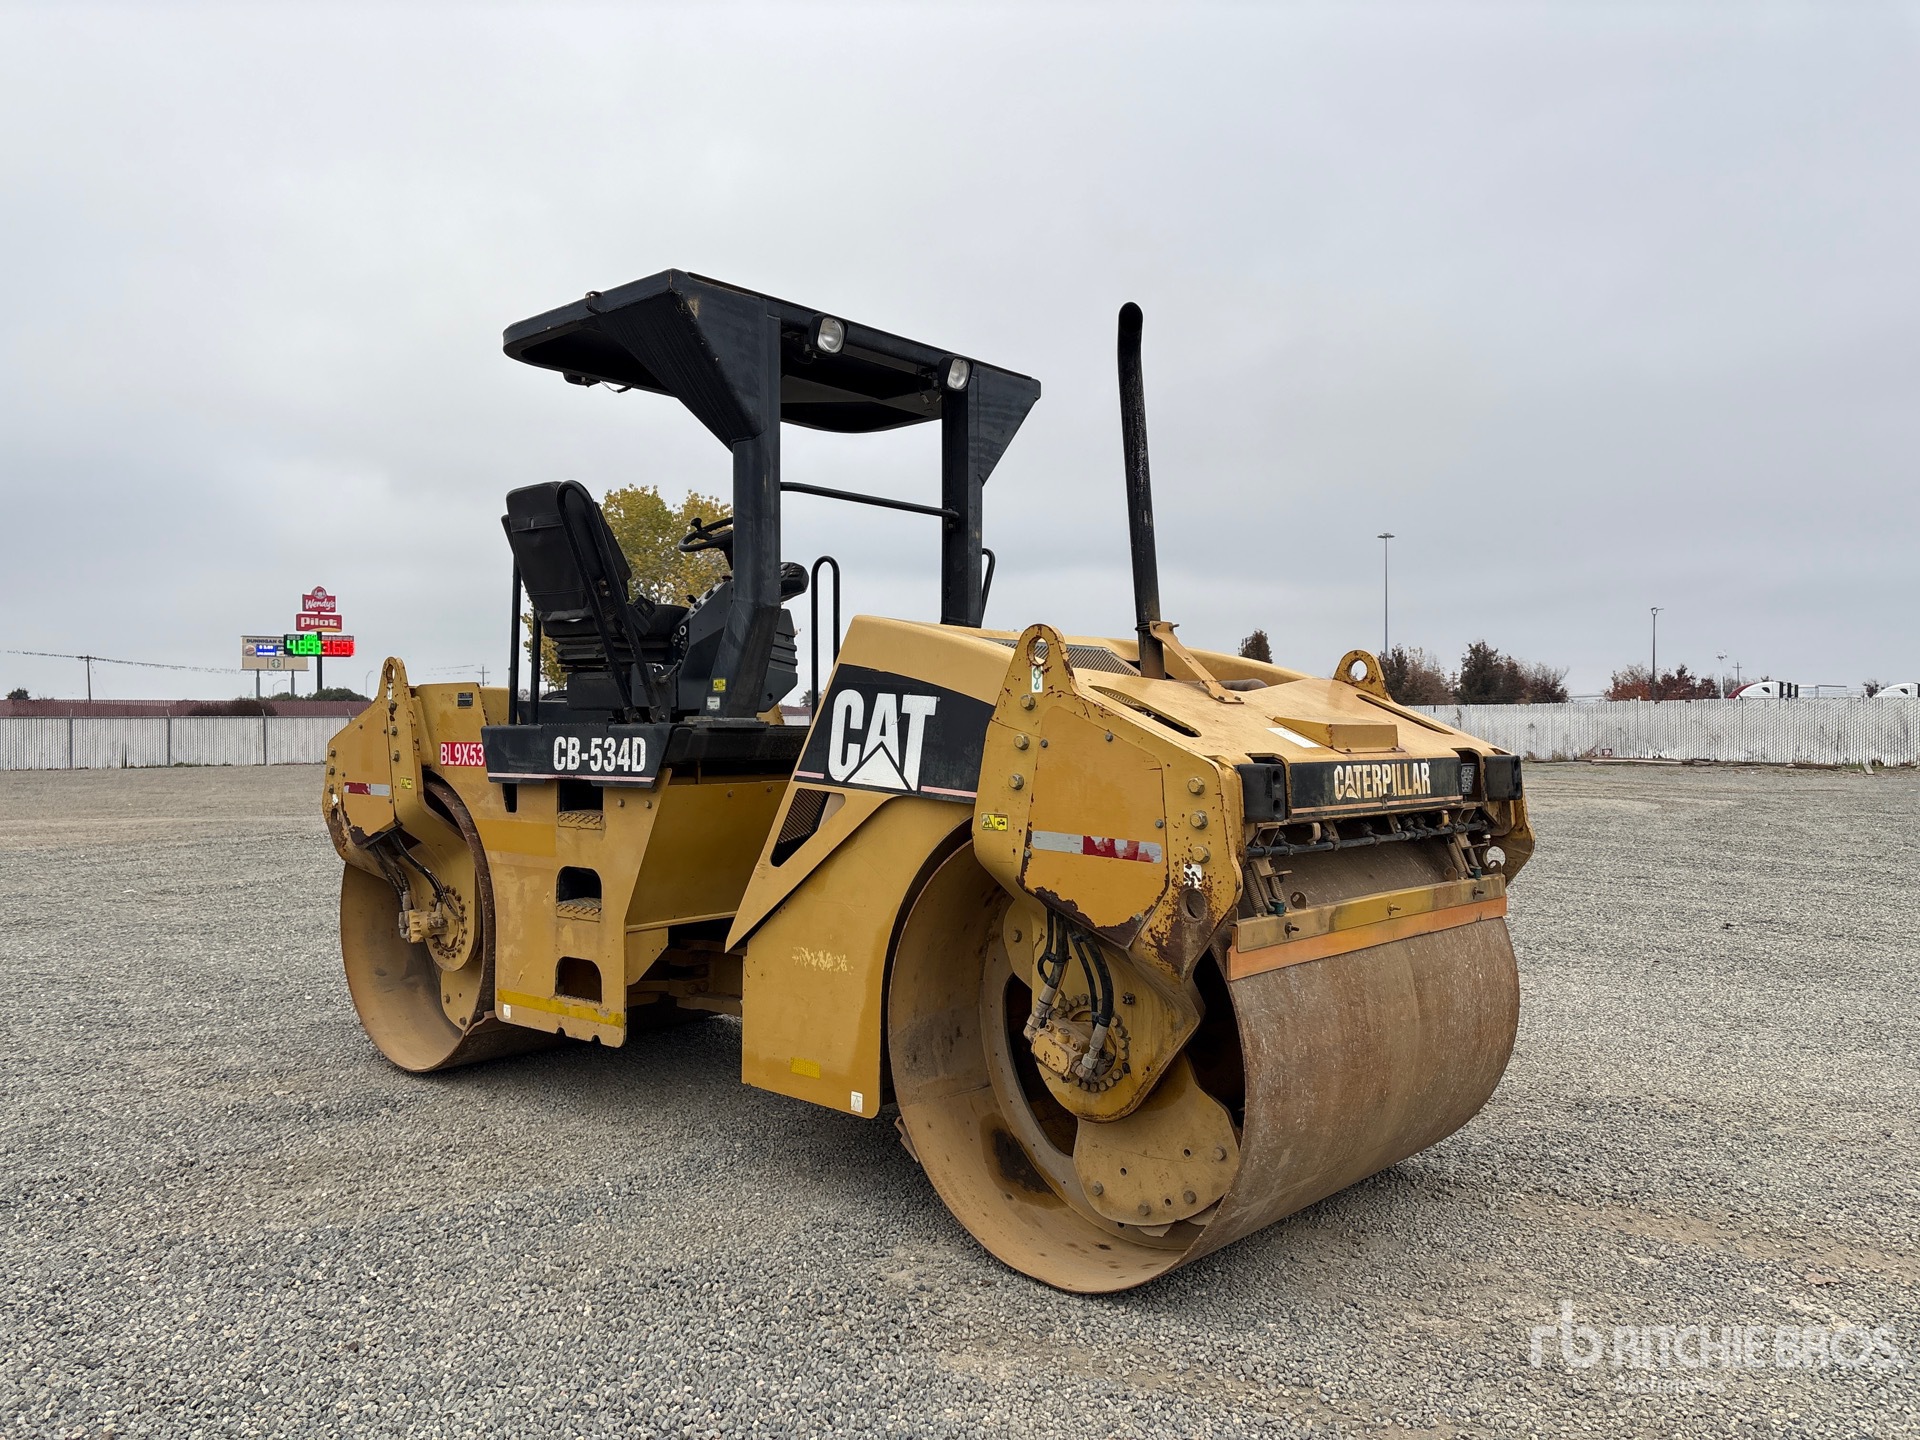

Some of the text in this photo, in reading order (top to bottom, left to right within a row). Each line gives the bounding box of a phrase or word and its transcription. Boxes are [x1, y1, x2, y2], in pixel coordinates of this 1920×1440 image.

[305, 599, 335, 610] Wendy's
[300, 617, 337, 627] Pilot
[440, 743, 484, 766] BL9X53
[553, 736, 647, 773] CB-534D
[828, 689, 937, 792] CAT
[1333, 762, 1431, 800] CATERPILLAR
